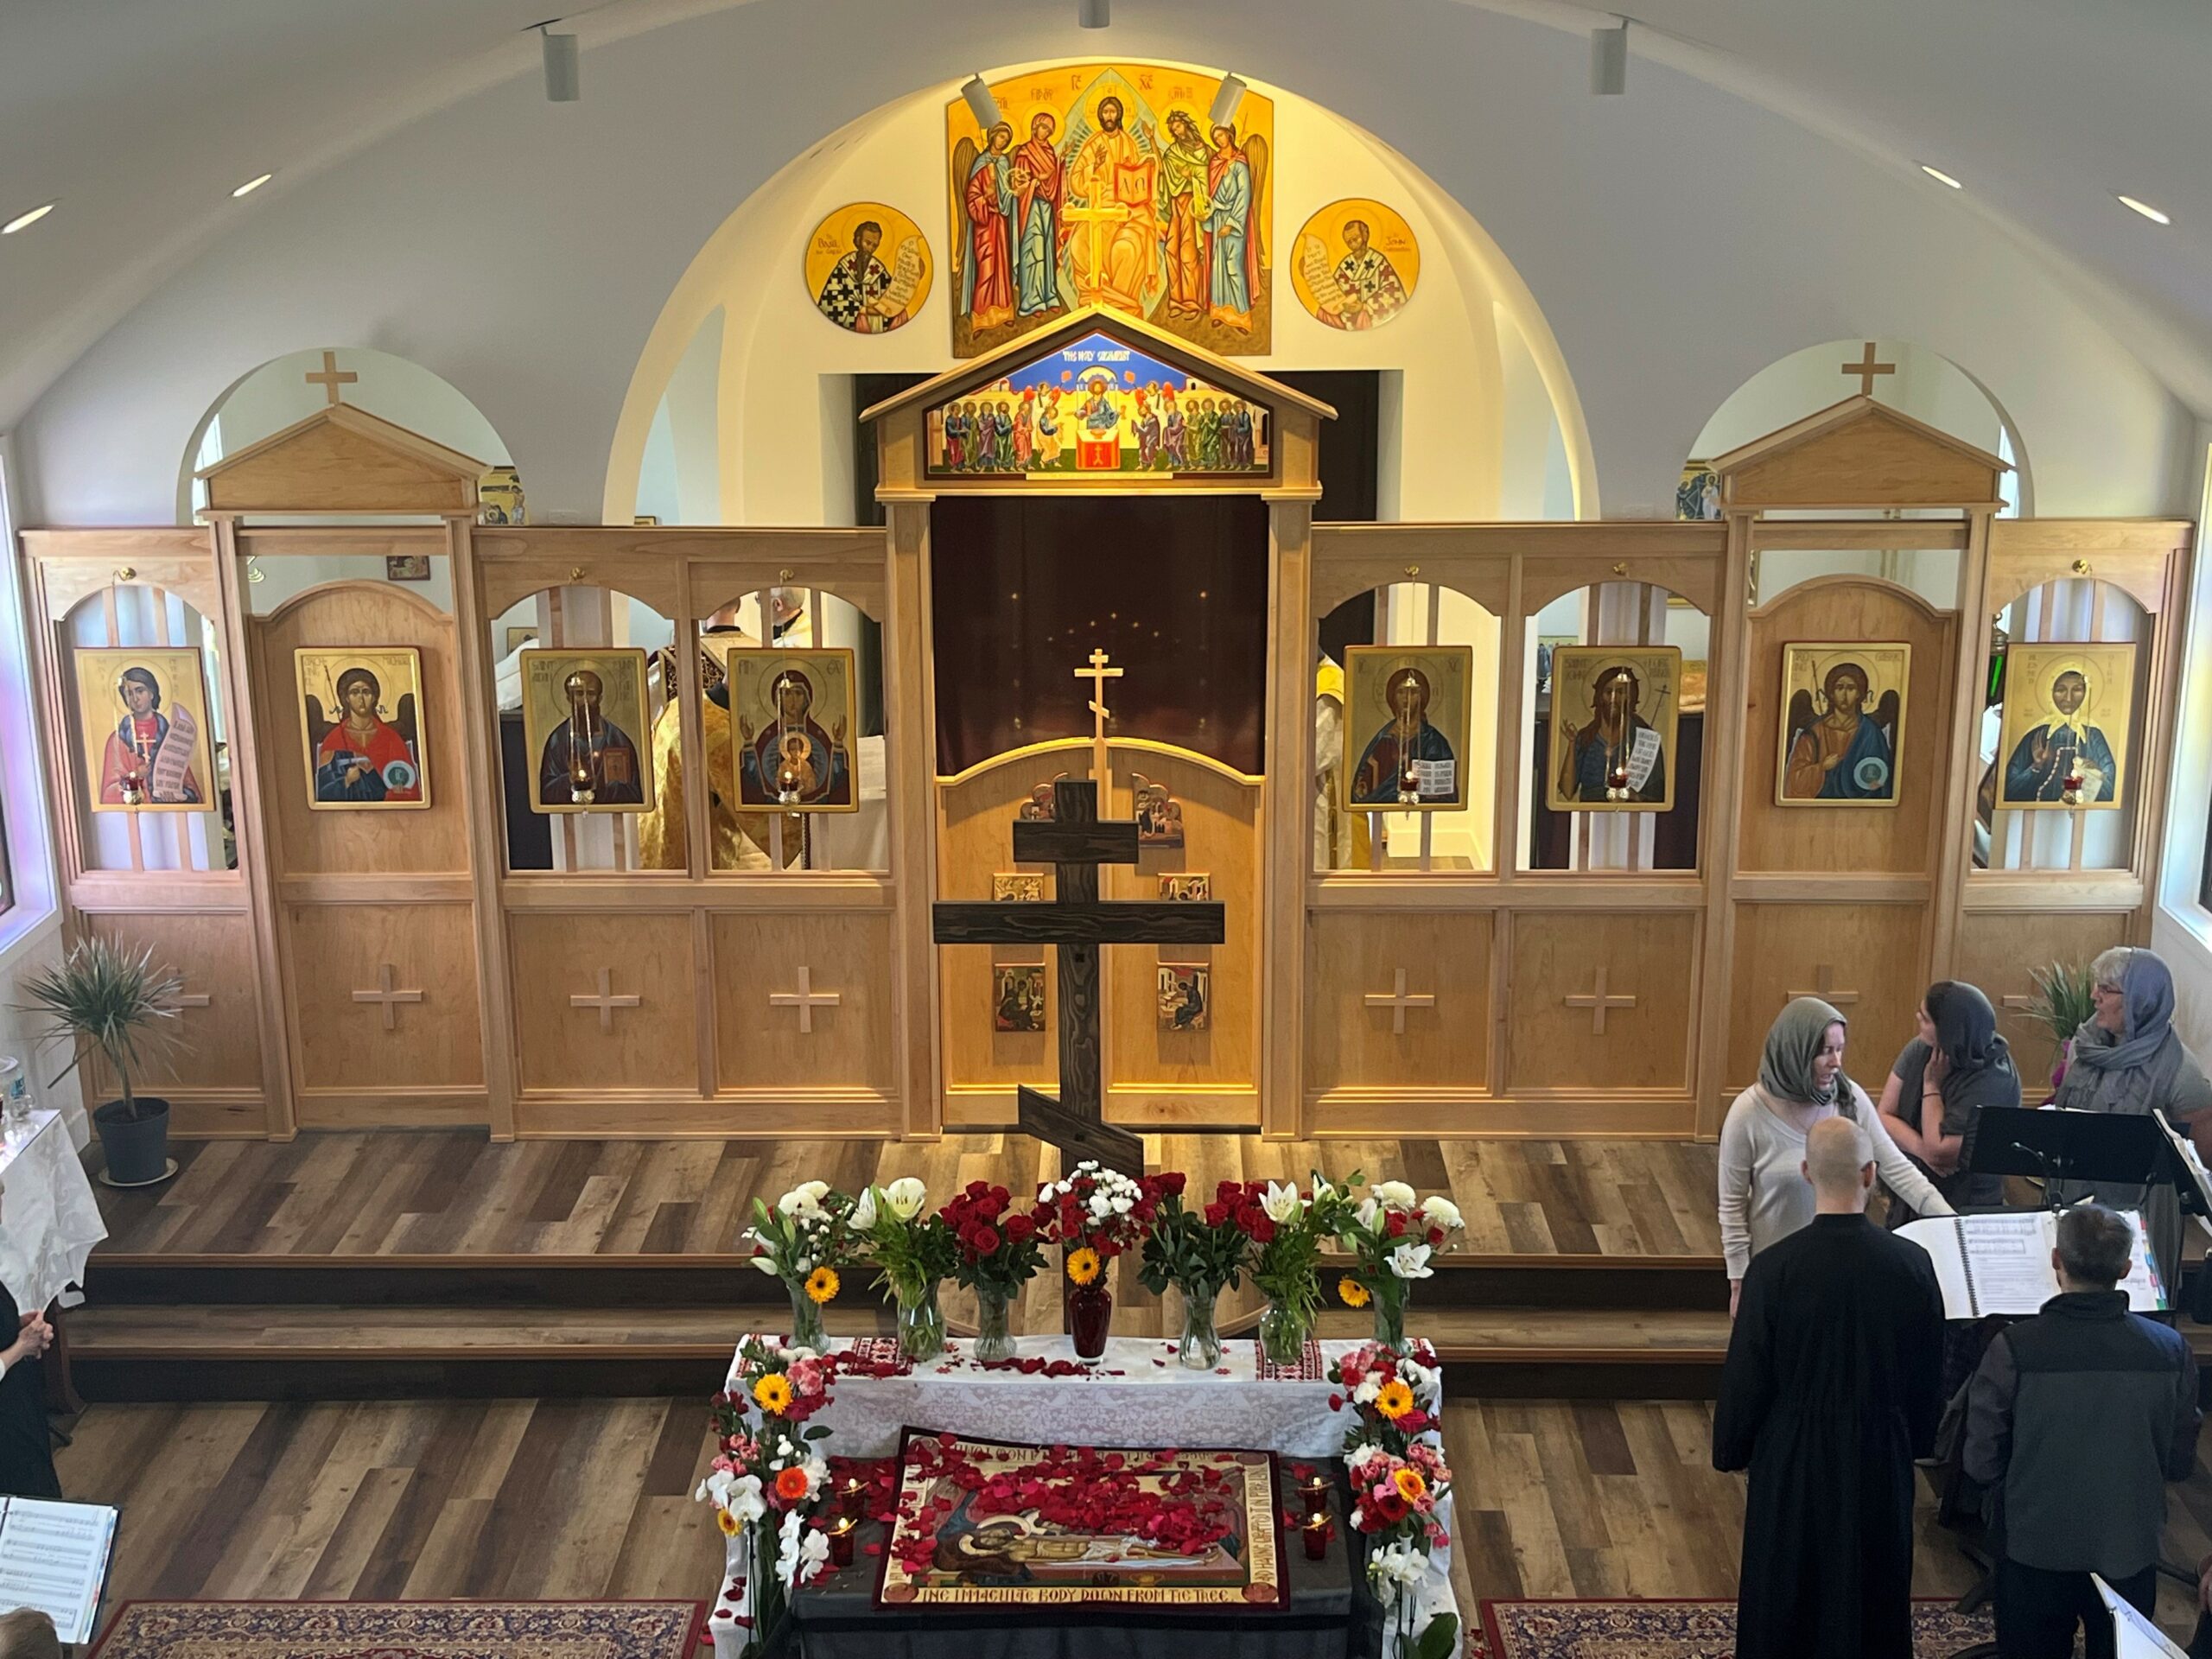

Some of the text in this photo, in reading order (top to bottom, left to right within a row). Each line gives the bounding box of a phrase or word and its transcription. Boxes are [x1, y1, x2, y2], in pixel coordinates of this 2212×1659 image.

[1039, 1589, 1077, 1602] BODY
[1081, 1589, 1122, 1601] DOWN
[1127, 1589, 1164, 1602] FROM
